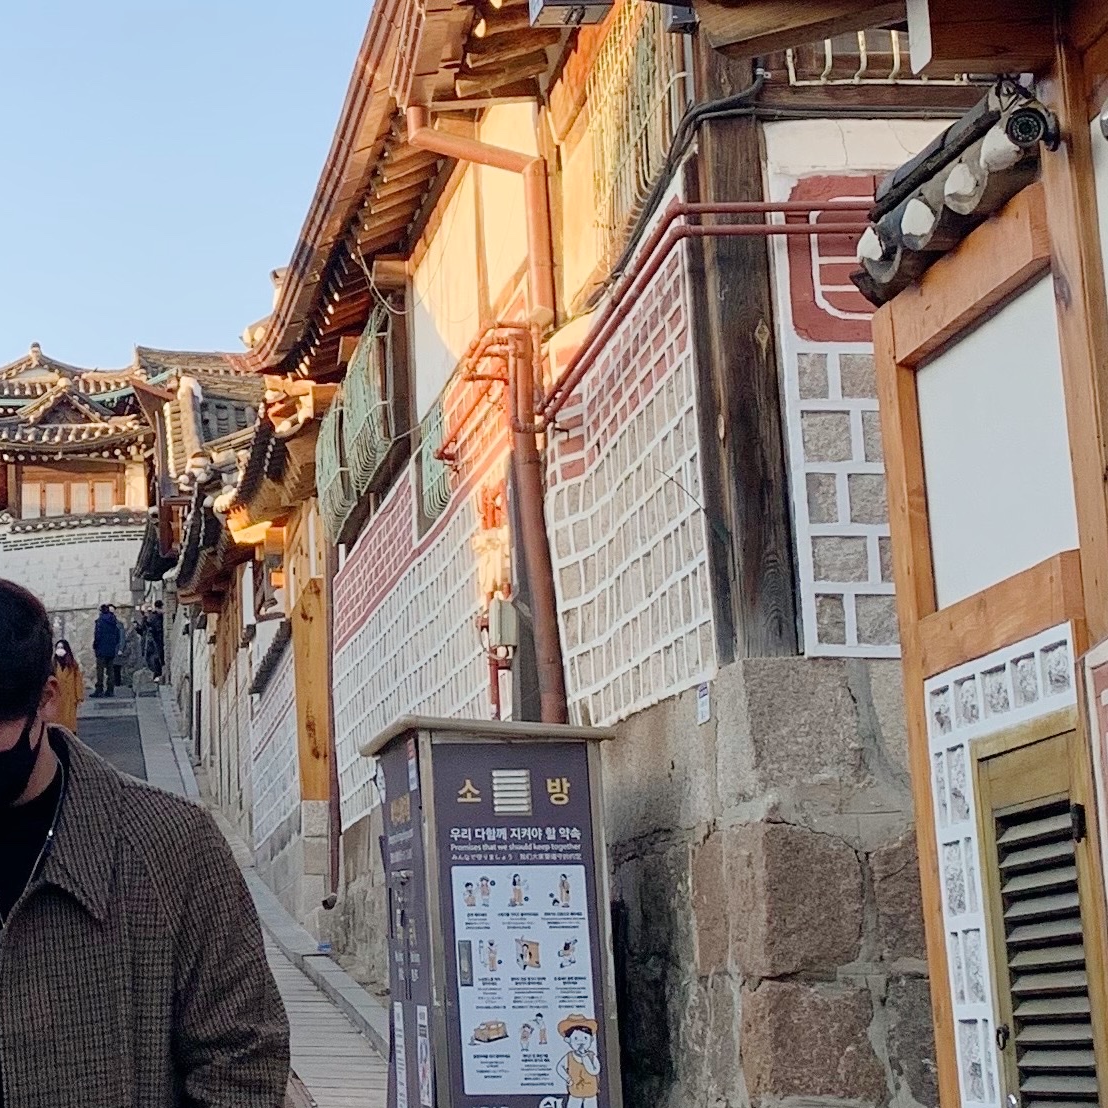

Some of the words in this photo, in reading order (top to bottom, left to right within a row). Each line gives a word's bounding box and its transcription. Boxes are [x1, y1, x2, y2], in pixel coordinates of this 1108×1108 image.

[456, 778, 482, 803] 소
[546, 777, 571, 805] 방
[450, 827, 472, 841] 우리
[474, 827, 507, 841] 다함께
[510, 827, 543, 841] 지켜야
[545, 827, 556, 841] 할
[558, 827, 582, 841] 약속
[450, 843, 482, 851] Promises
[482, 843, 497, 851] that
[508, 843, 532, 851] should
[533, 843, 550, 852] keep
[550, 843, 581, 852] together
